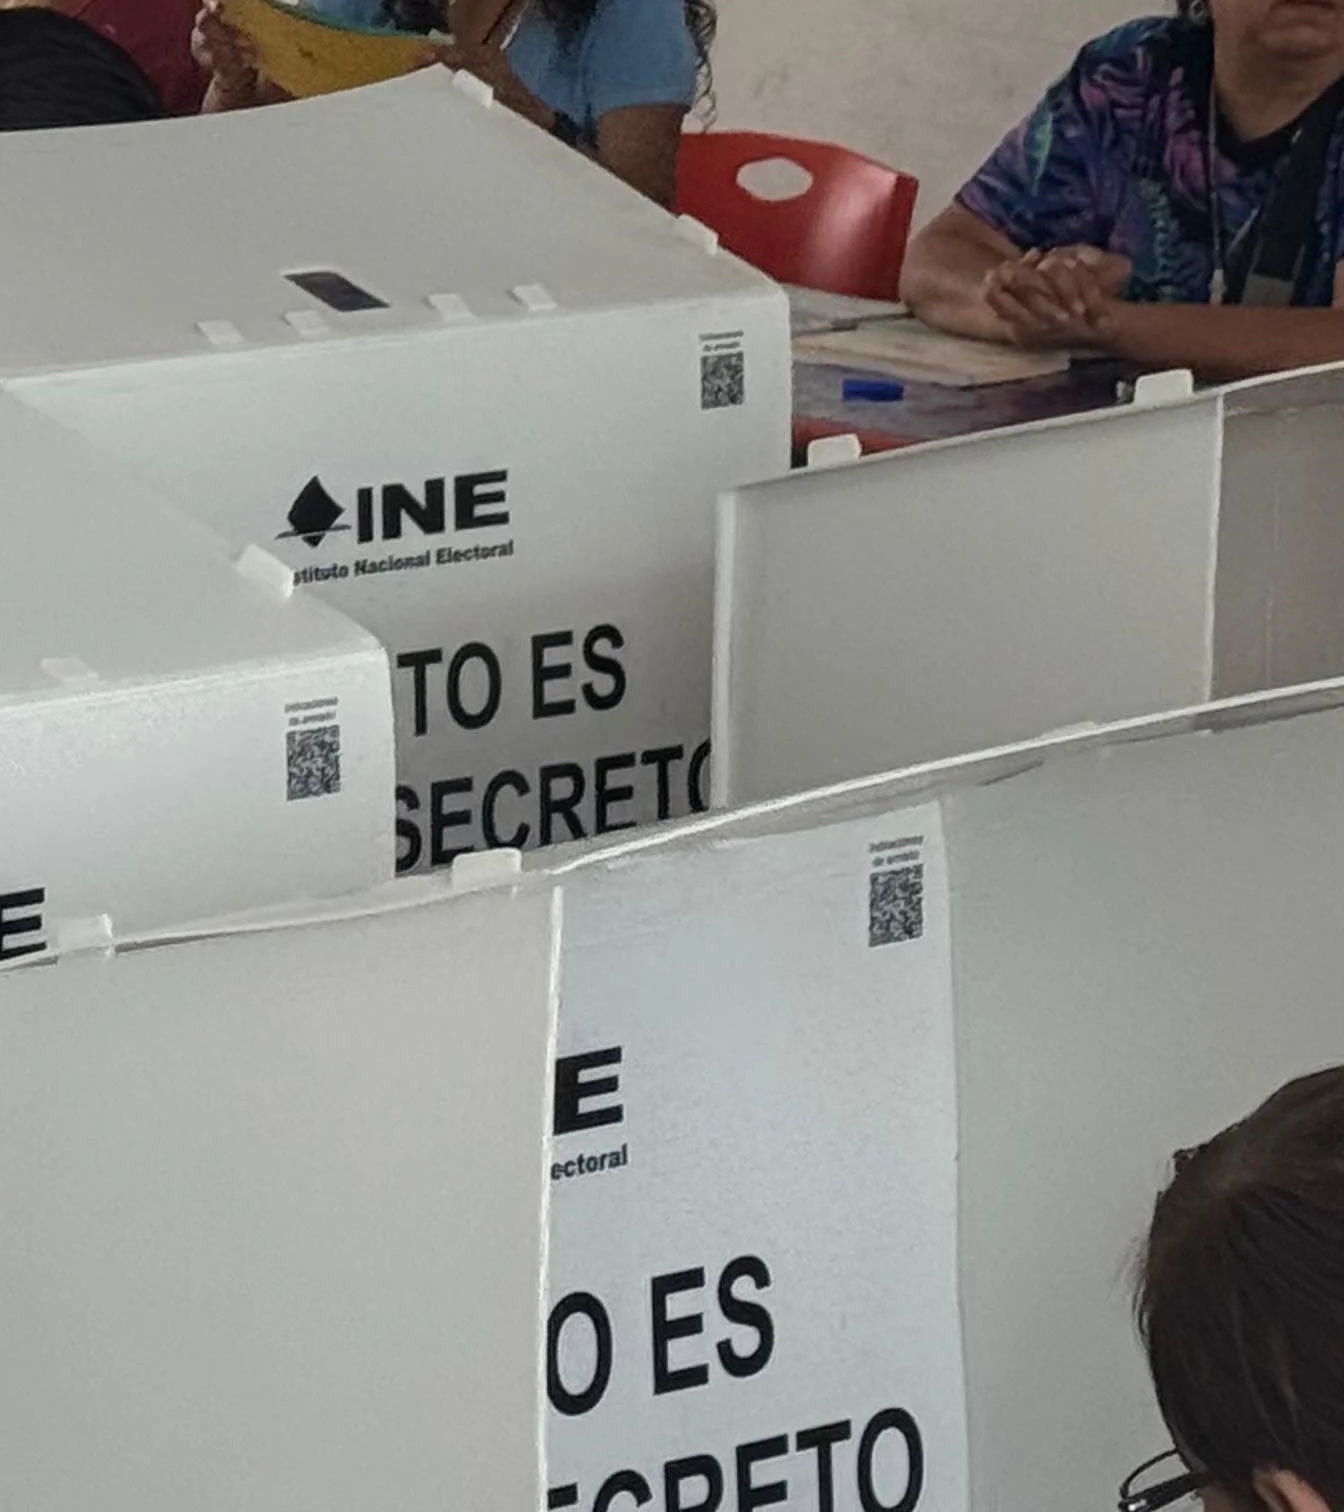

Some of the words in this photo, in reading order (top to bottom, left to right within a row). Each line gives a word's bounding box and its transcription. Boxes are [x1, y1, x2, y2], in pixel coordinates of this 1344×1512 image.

[357, 468, 510, 545] INE
[354, 549, 431, 577] Nacional
[436, 539, 515, 565] Electoral
[397, 641, 502, 737] TO
[531, 624, 627, 720] ES
[550, 1143, 627, 1180] ectoral
[650, 1254, 775, 1396] ES
